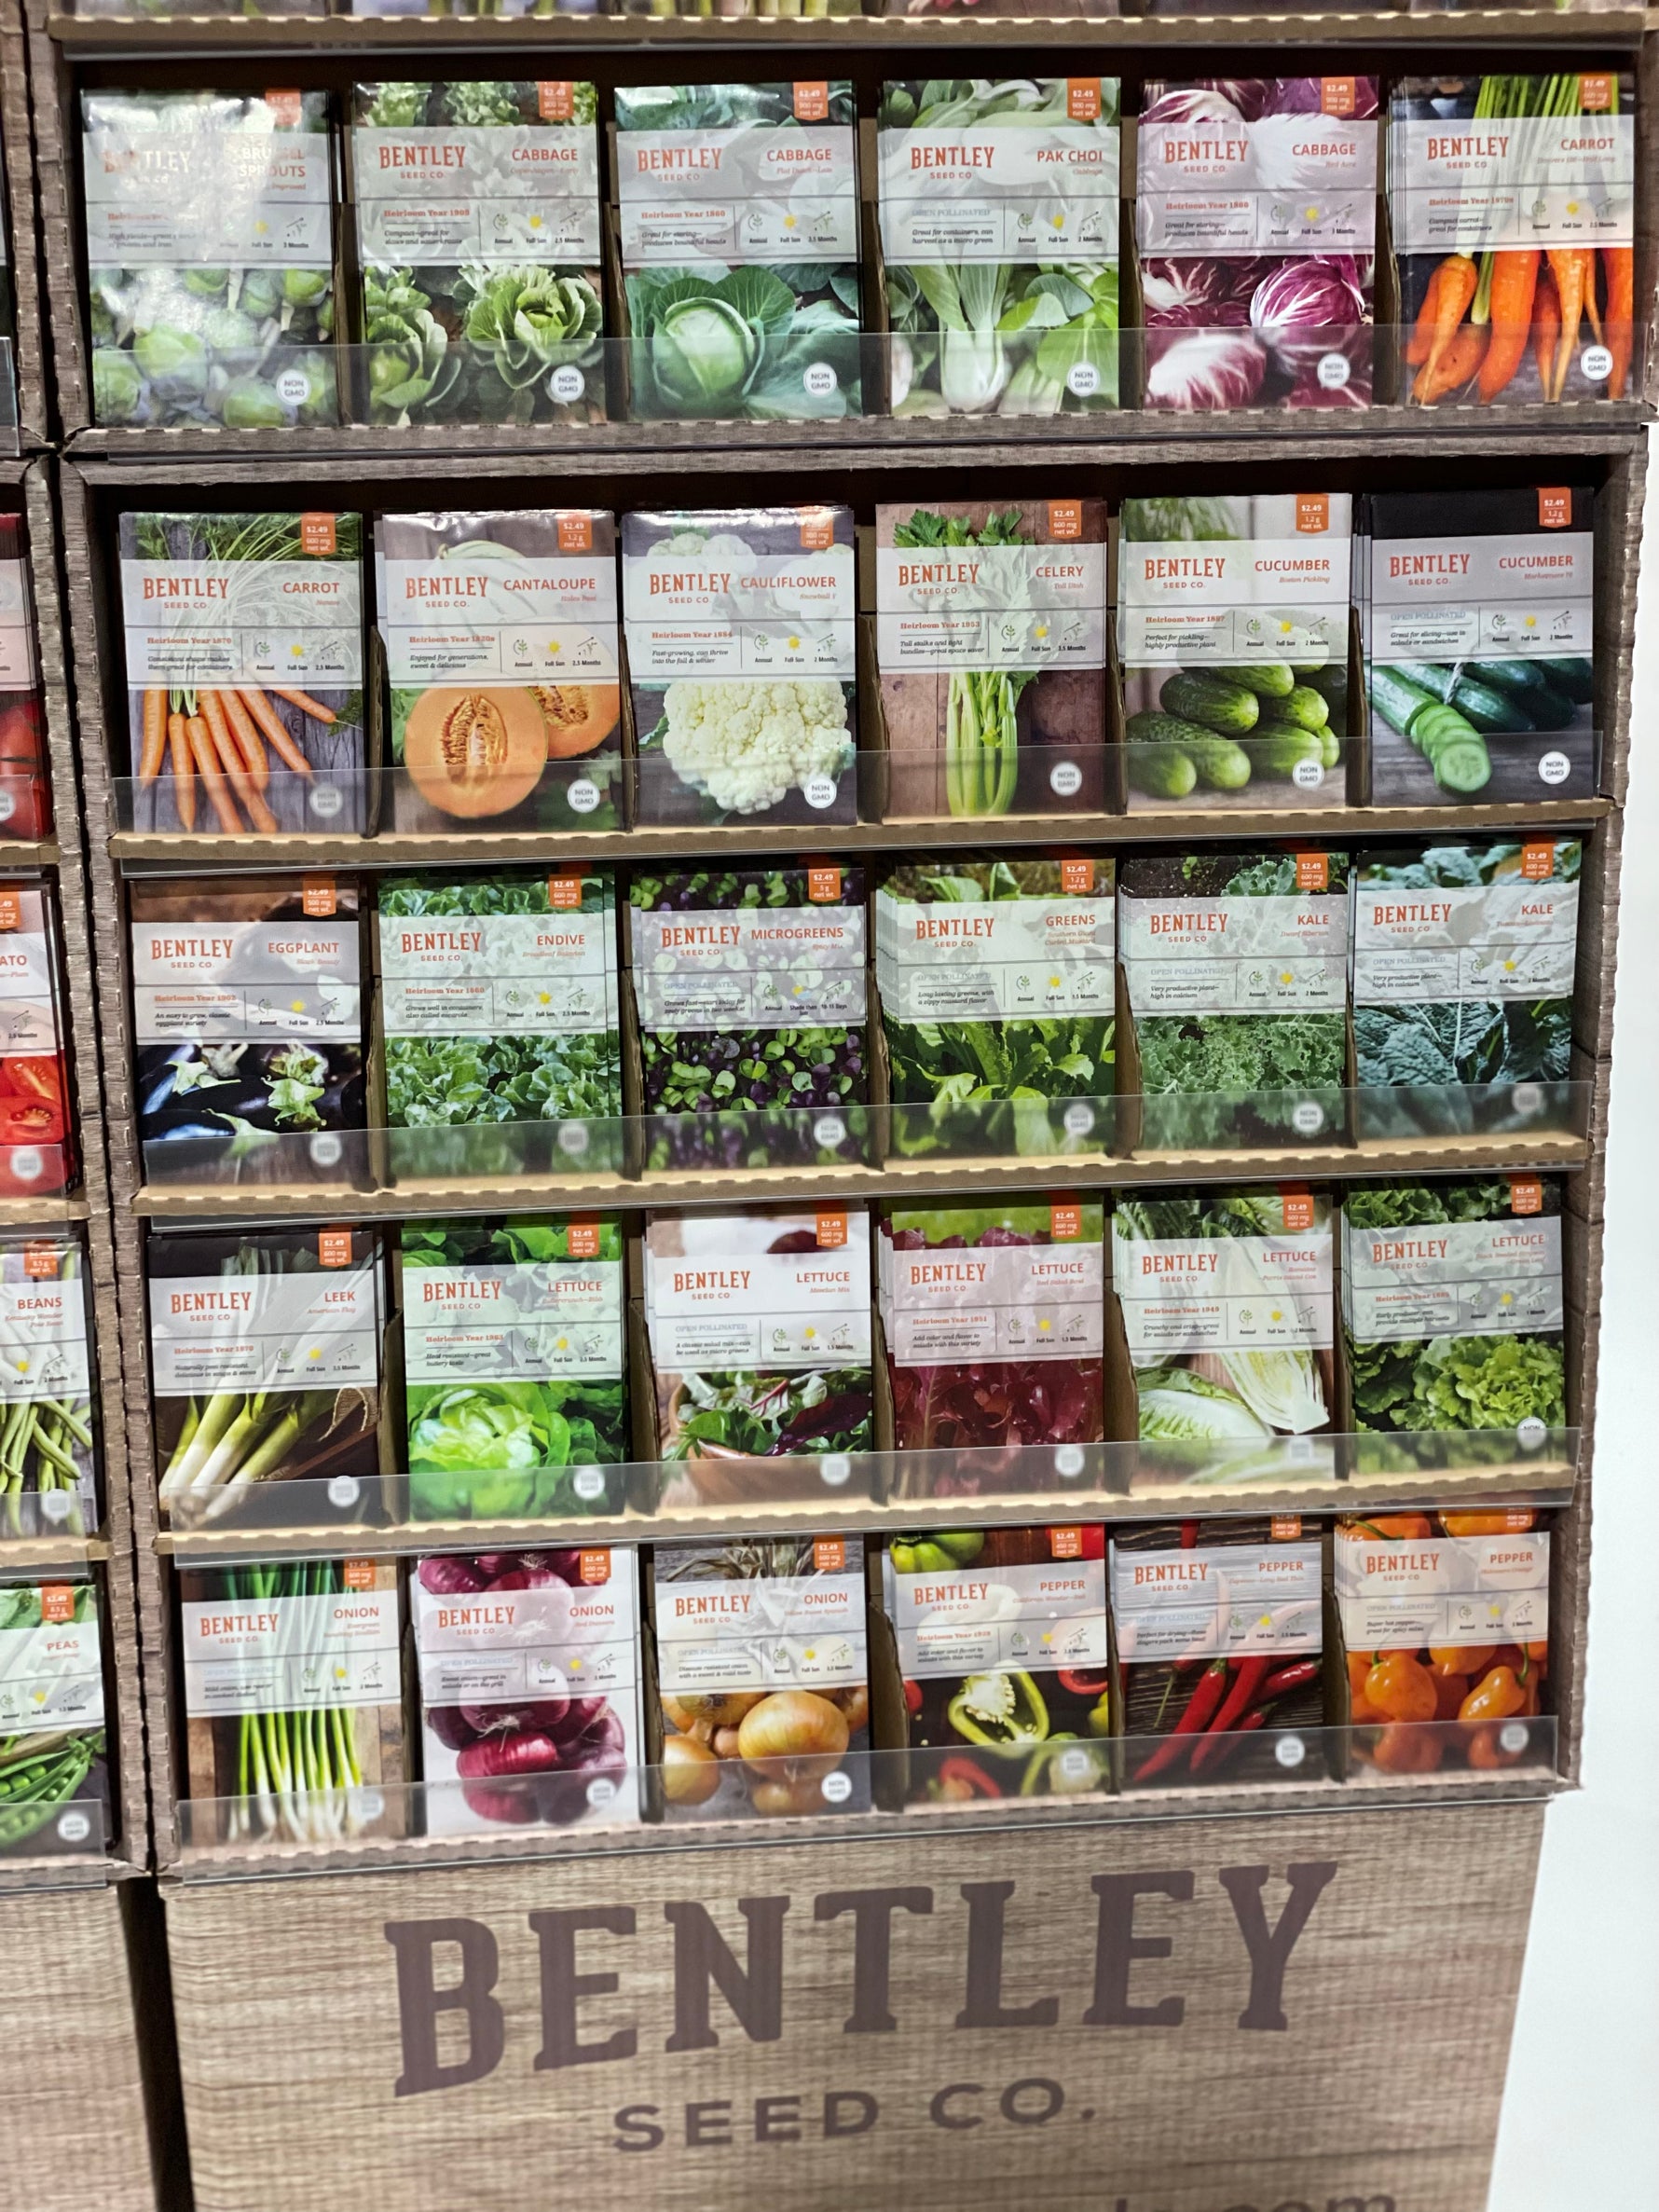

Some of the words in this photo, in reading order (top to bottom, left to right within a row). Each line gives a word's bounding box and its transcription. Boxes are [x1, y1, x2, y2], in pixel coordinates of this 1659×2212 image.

[1072, 89, 1094, 98] $2.49
[1292, 144, 1357, 156] CABBAGE
[1428, 137, 1508, 159] BENTLEY
[1560, 138, 1614, 150] CARROT
[380, 146, 465, 169] BENTLEY
[512, 149, 579, 162] CABBAGE
[767, 149, 832, 161] CABBAGE
[912, 146, 994, 169] BENTLEY
[1036, 151, 1063, 162] PAK
[1068, 150, 1103, 161] CHOI
[1165, 141, 1248, 163] BENTLEY
[638, 148, 722, 171] BENTLEY
[1301, 504, 1323, 513] $2.49
[1543, 499, 1565, 507] $2.49
[1054, 510, 1076, 518] $2.49
[306, 525, 328, 534] $2.49
[1255, 560, 1330, 571] CUCUMBER
[1391, 555, 1470, 576] BENTLEY
[1499, 556, 1574, 569] CUCUMBER
[899, 564, 979, 585] BENTLEY
[1035, 567, 1084, 578] CELERY
[1145, 558, 1226, 580] BENTLEY
[144, 577, 228, 599] BENTLEY
[282, 582, 339, 594] CARROT
[405, 576, 488, 598] BENTLEY
[503, 579, 596, 591] CANTALOUPE
[651, 573, 731, 595] BENTLEY
[740, 577, 836, 588] CAULIFLOWER
[1527, 852, 1547, 860] $2.49
[1065, 864, 1087, 873] $2.49
[1301, 862, 1322, 871] $2.49
[814, 873, 834, 882] $2.49
[554, 880, 575, 888] $2.49
[1374, 904, 1451, 925] BENTLEY
[1521, 904, 1554, 914] KALE
[1046, 914, 1096, 927] GREENS
[1151, 914, 1227, 934] BENTLEY
[1297, 914, 1329, 925] KALE
[751, 927, 844, 940] MICROGREENS
[916, 918, 994, 940] BENTLEY
[403, 933, 480, 954] BENTLEY
[537, 935, 585, 946] ENDIVE
[662, 927, 740, 948] BENTLEY
[152, 940, 233, 960] BENTLEY
[267, 942, 339, 954] EGGPLANT
[1055, 1212, 1076, 1220] $2.49
[821, 1220, 841, 1229] $2.49
[572, 1230, 594, 1239] $2.49
[323, 1239, 345, 1247] $2.49
[1492, 1235, 1544, 1247] LETTUCE
[1263, 1252, 1316, 1262] LETTUCE
[1374, 1241, 1447, 1262] BENTLEY
[1032, 1263, 1084, 1274] LETTUCE
[1143, 1254, 1217, 1274] BENTLEY
[796, 1272, 850, 1283] LETTUCE
[912, 1264, 986, 1285] BENTLEY
[547, 1281, 603, 1293] LETTUCE
[674, 1271, 749, 1292] BENTLEY
[324, 1291, 356, 1302] LEEK
[424, 1281, 501, 1302] BENTLEY
[17, 1297, 62, 1310] BEANS
[171, 1292, 251, 1312] BENTLEY
[1490, 1552, 1534, 1563] PEPPER
[1259, 1561, 1304, 1572] PEPPER
[1366, 1554, 1439, 1574] BENTLEY
[1135, 1563, 1208, 1585] BENTLEY
[1040, 1580, 1086, 1591] PEPPER
[803, 1593, 848, 1604] ONION
[914, 1584, 988, 1604] BENTLEY
[569, 1605, 614, 1616] ONION
[676, 1595, 749, 1616] BENTLEY
[334, 1607, 379, 1619] ONION
[439, 1606, 514, 1628] BENTLEY
[200, 1614, 279, 1636] BENTLEY
[47, 1640, 79, 1651] PEAS
[384, 1862, 1338, 2097] BENTLEY
[613, 2090, 881, 2152] SEED
[931, 2077, 1097, 2130] CO.
